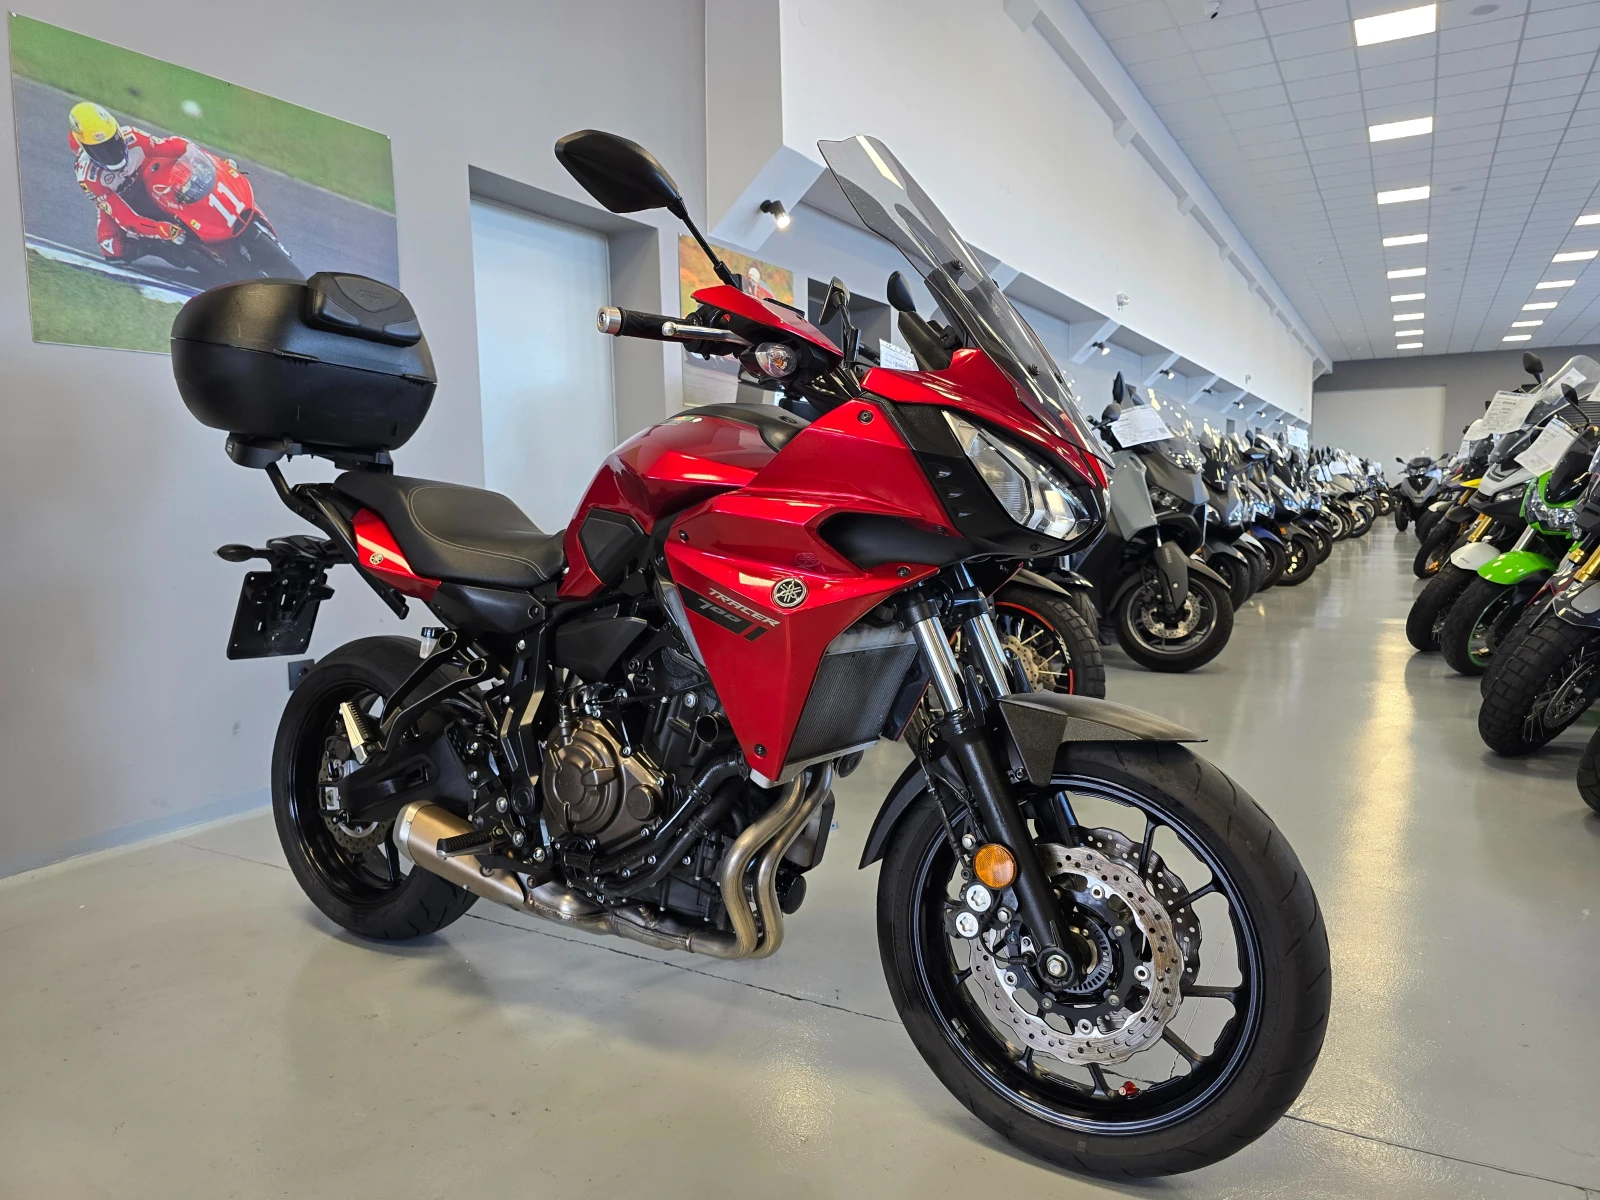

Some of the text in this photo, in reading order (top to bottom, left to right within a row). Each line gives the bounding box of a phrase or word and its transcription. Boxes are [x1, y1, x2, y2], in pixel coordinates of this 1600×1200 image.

[208, 181, 246, 228] 11
[698, 598, 742, 623] 700
[709, 588, 780, 627] TRACER
